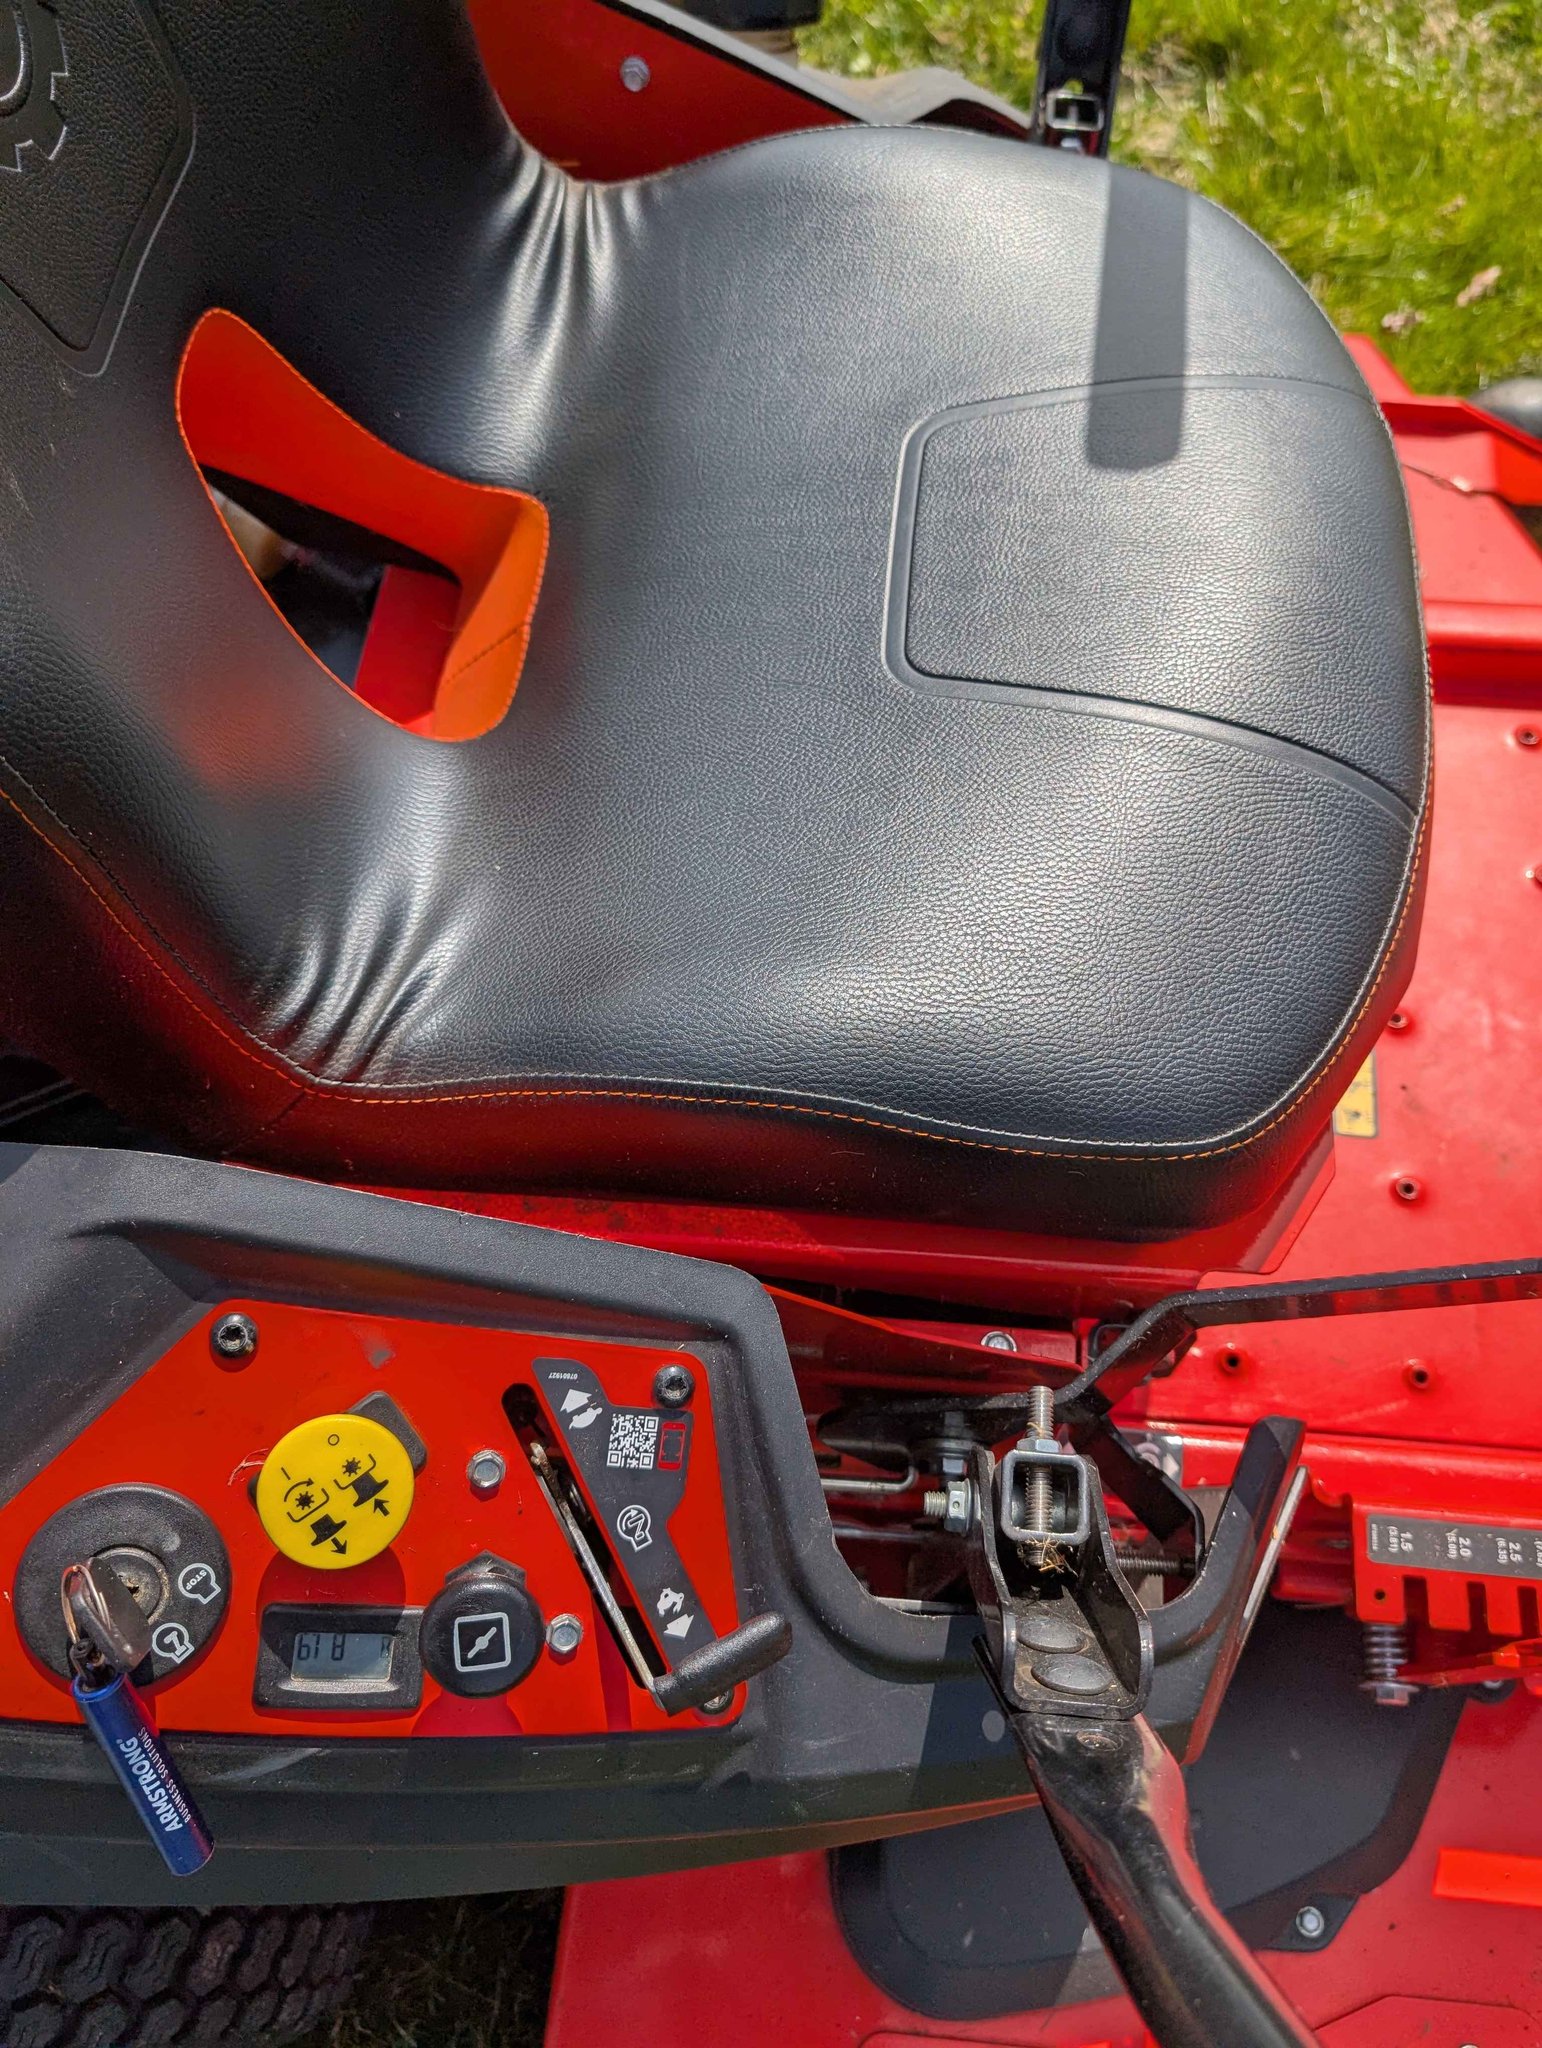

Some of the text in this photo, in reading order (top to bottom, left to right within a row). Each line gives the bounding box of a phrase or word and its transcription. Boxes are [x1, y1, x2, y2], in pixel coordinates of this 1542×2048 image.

[1401, 1531, 1413, 1553] 1.5
[1459, 1536, 1472, 1559] 2.0
[1495, 1537, 1508, 1565] (6.35)
[1508, 1542, 1522, 1564] 2.5
[186, 1569, 207, 1591] STOP
[138, 1726, 192, 1823] BUSINESS SOLUTIONS
